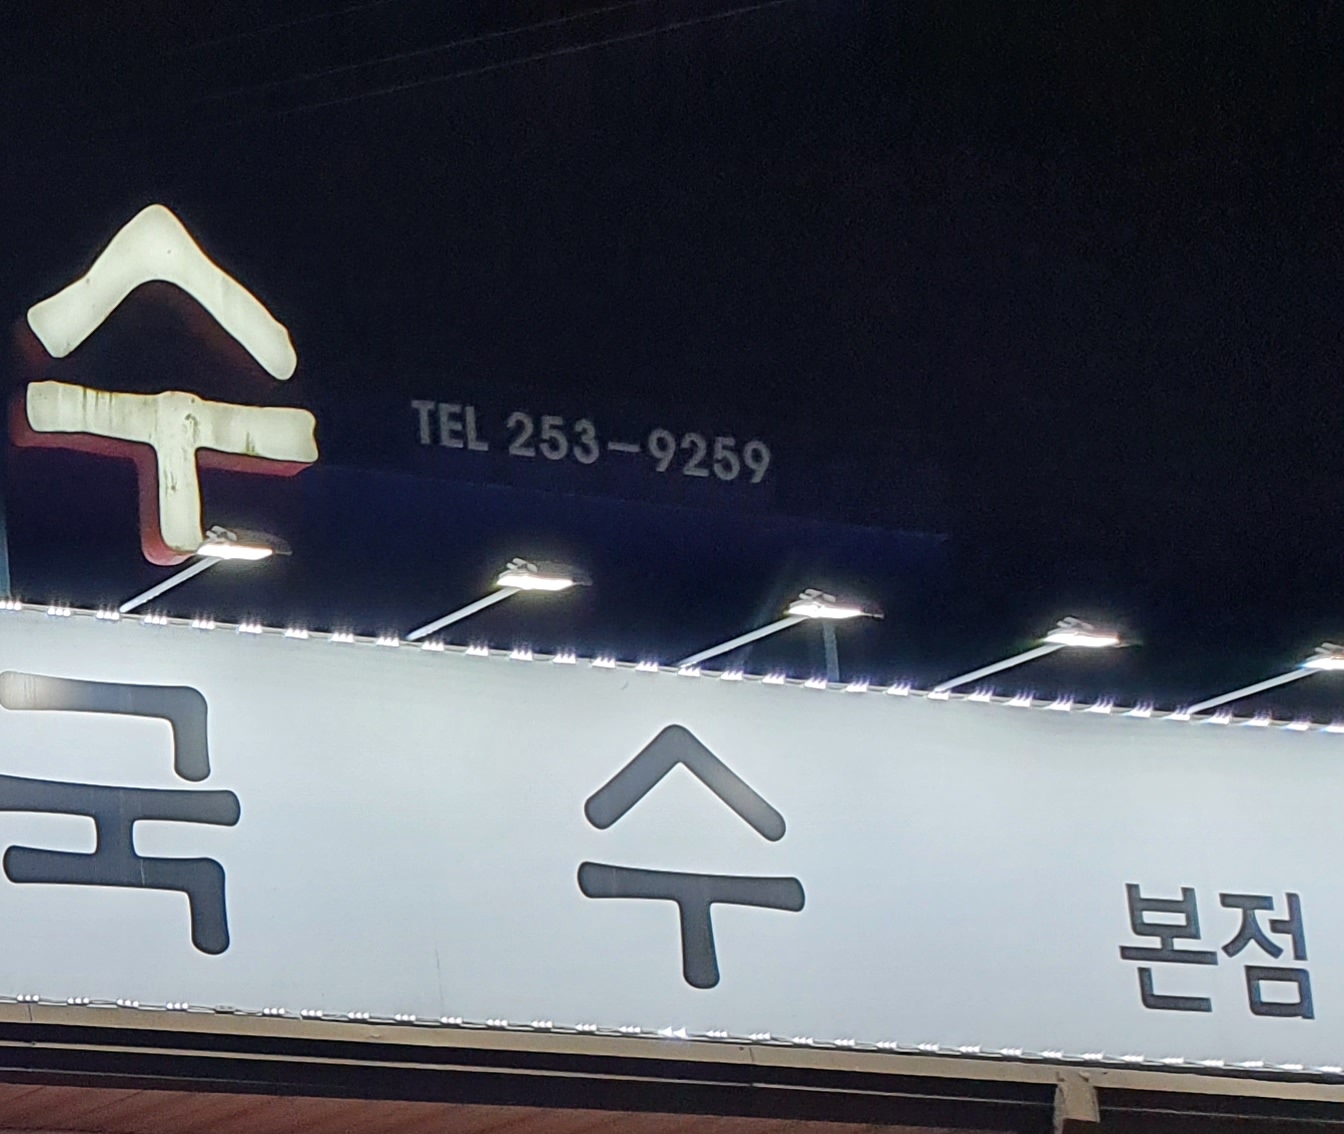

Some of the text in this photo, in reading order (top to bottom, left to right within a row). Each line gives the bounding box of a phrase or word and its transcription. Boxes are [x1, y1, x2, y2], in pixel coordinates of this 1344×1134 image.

[410, 399, 773, 485] TEL 253-9259
[1117, 881, 1316, 1021] 본점
